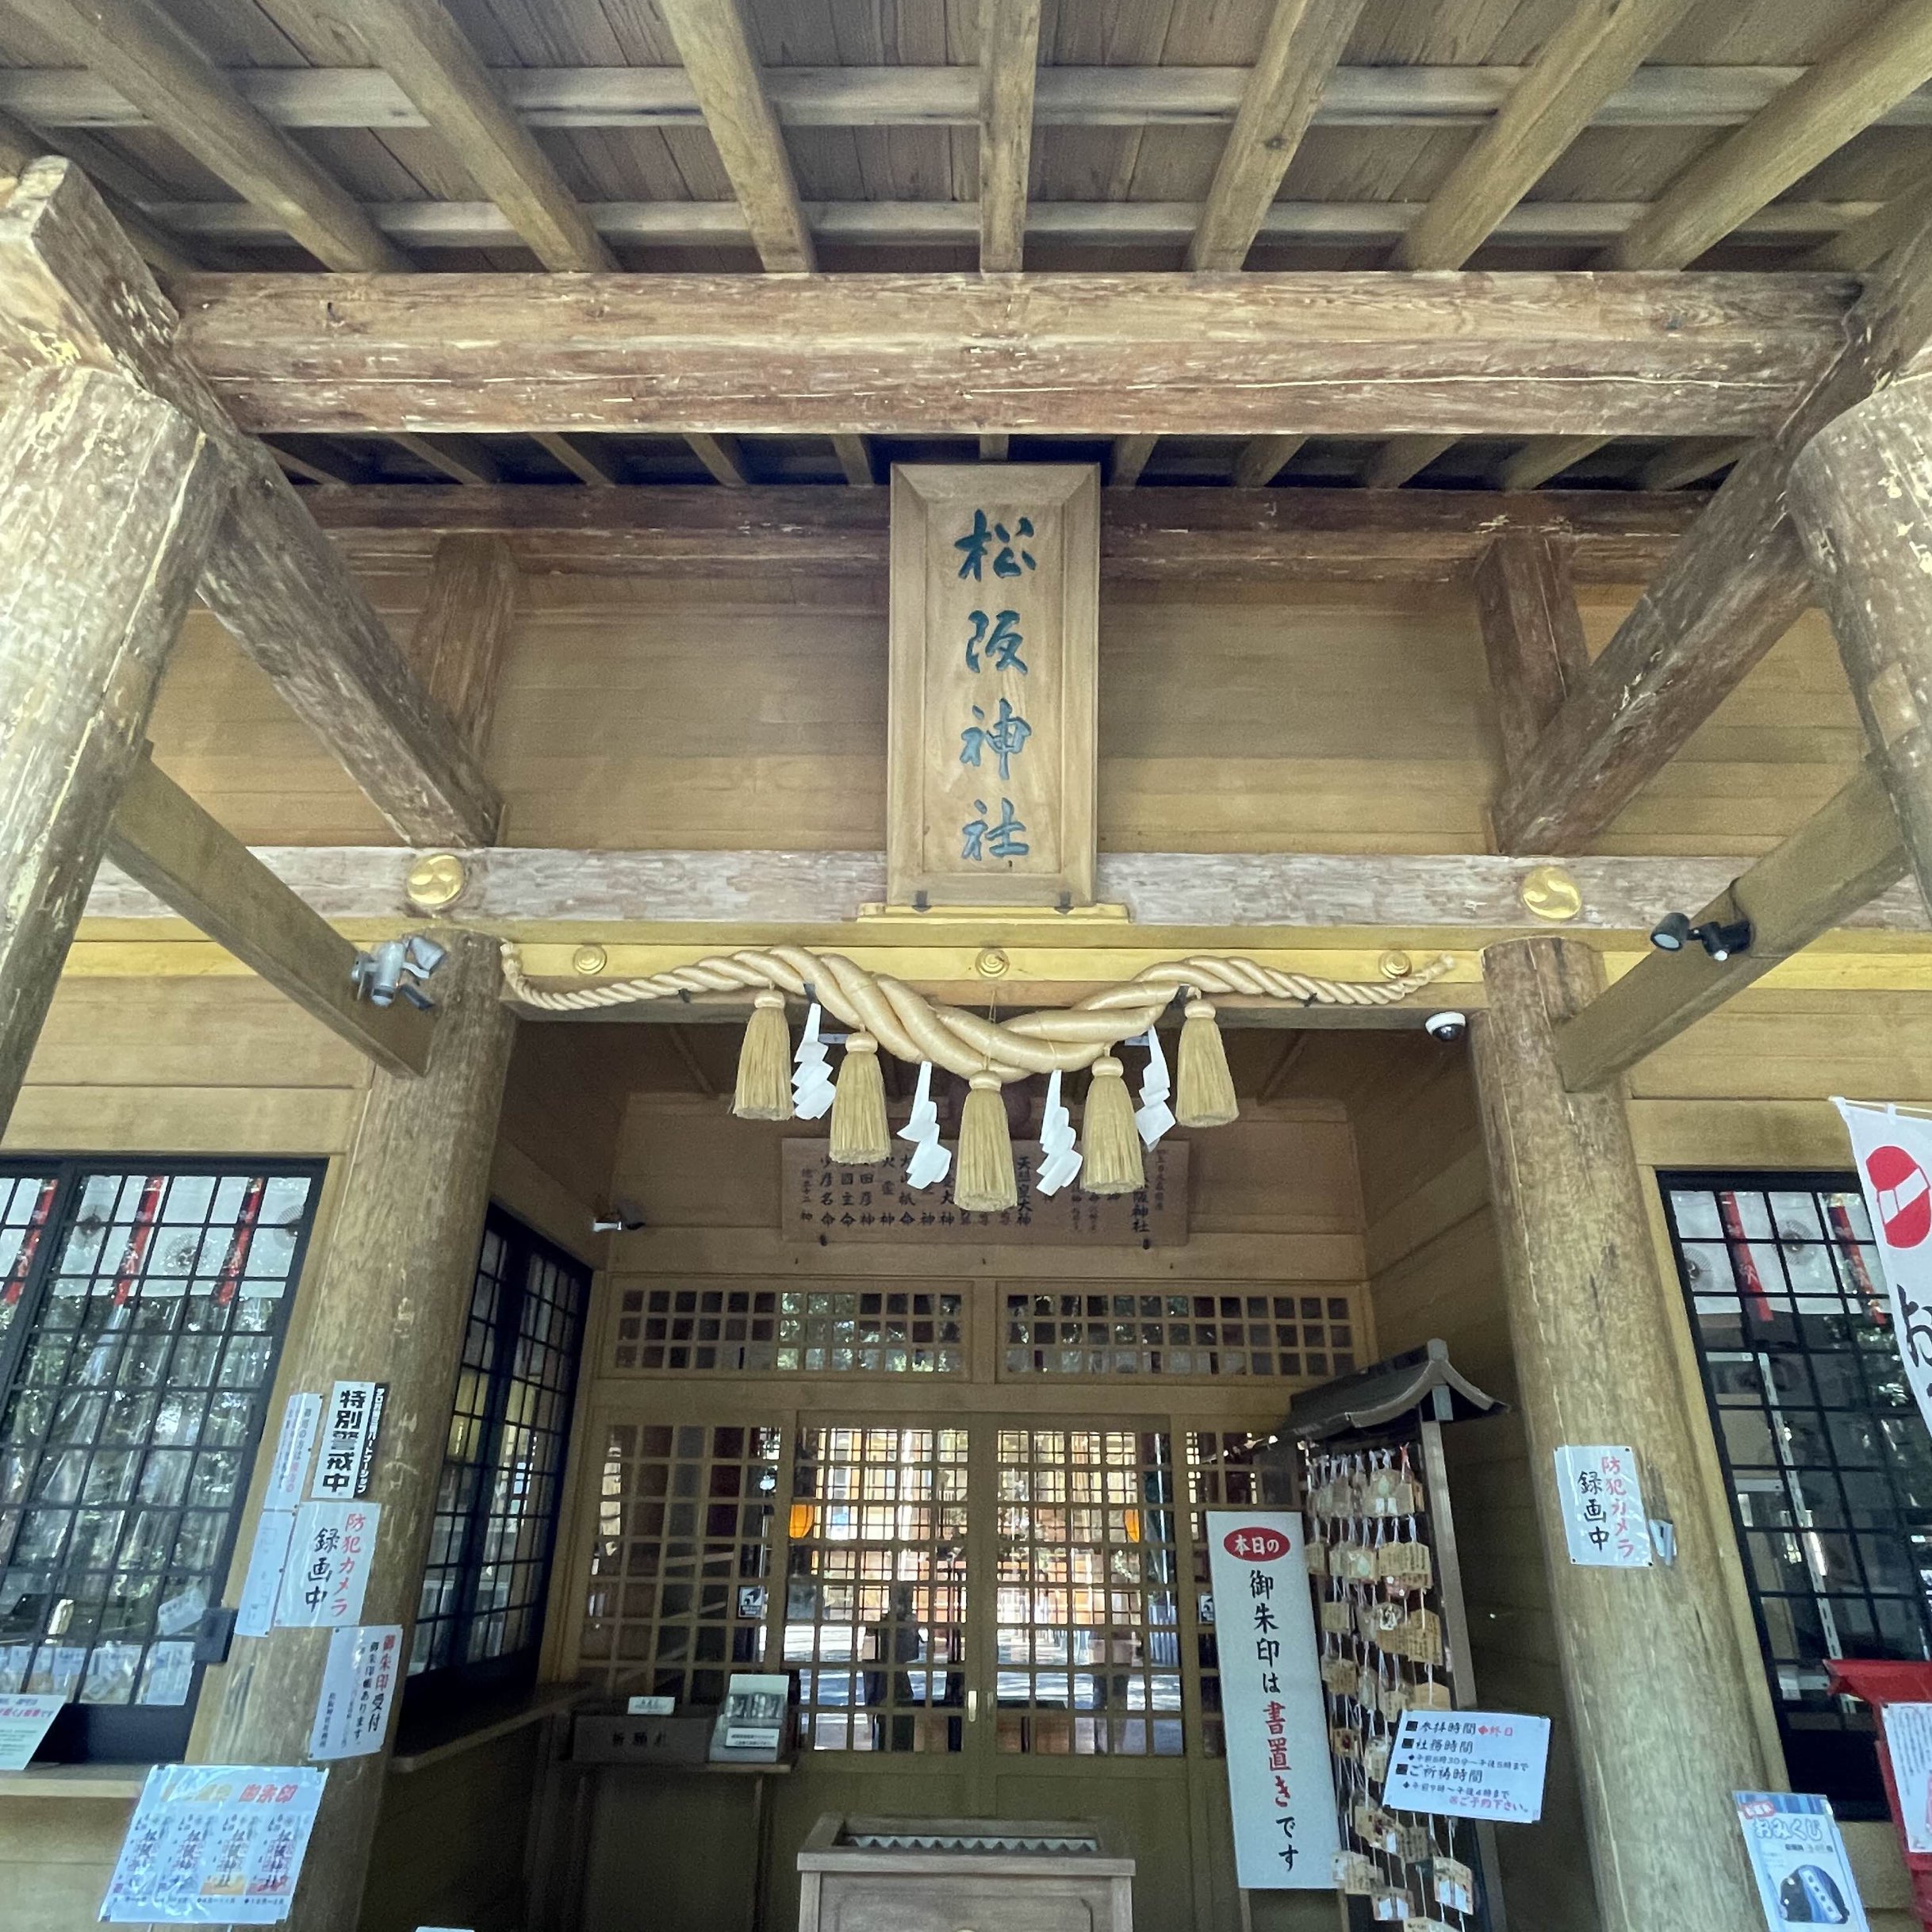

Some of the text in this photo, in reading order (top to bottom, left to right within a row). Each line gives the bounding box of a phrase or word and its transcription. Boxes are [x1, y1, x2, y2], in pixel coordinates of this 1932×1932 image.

[955, 509, 1037, 861] 松阪神社
[840, 1163, 856, 1227] 國主命
[859, 1163, 875, 1226] 田彦神
[1131, 1175, 1151, 1232] 阪神社
[322, 1389, 366, 1493] 特別警戒中
[1233, 1534, 1280, 1555] 本日の
[1577, 1470, 1610, 1552] 録画中
[1601, 1456, 1635, 1559] 防犯カメラ
[305, 1527, 341, 1613] 録画中
[331, 1512, 366, 1617] 防犯カメラ
[1249, 1569, 1299, 1873] 御朱印は書置きです
[1753, 1817, 1823, 1842] おみくじ
